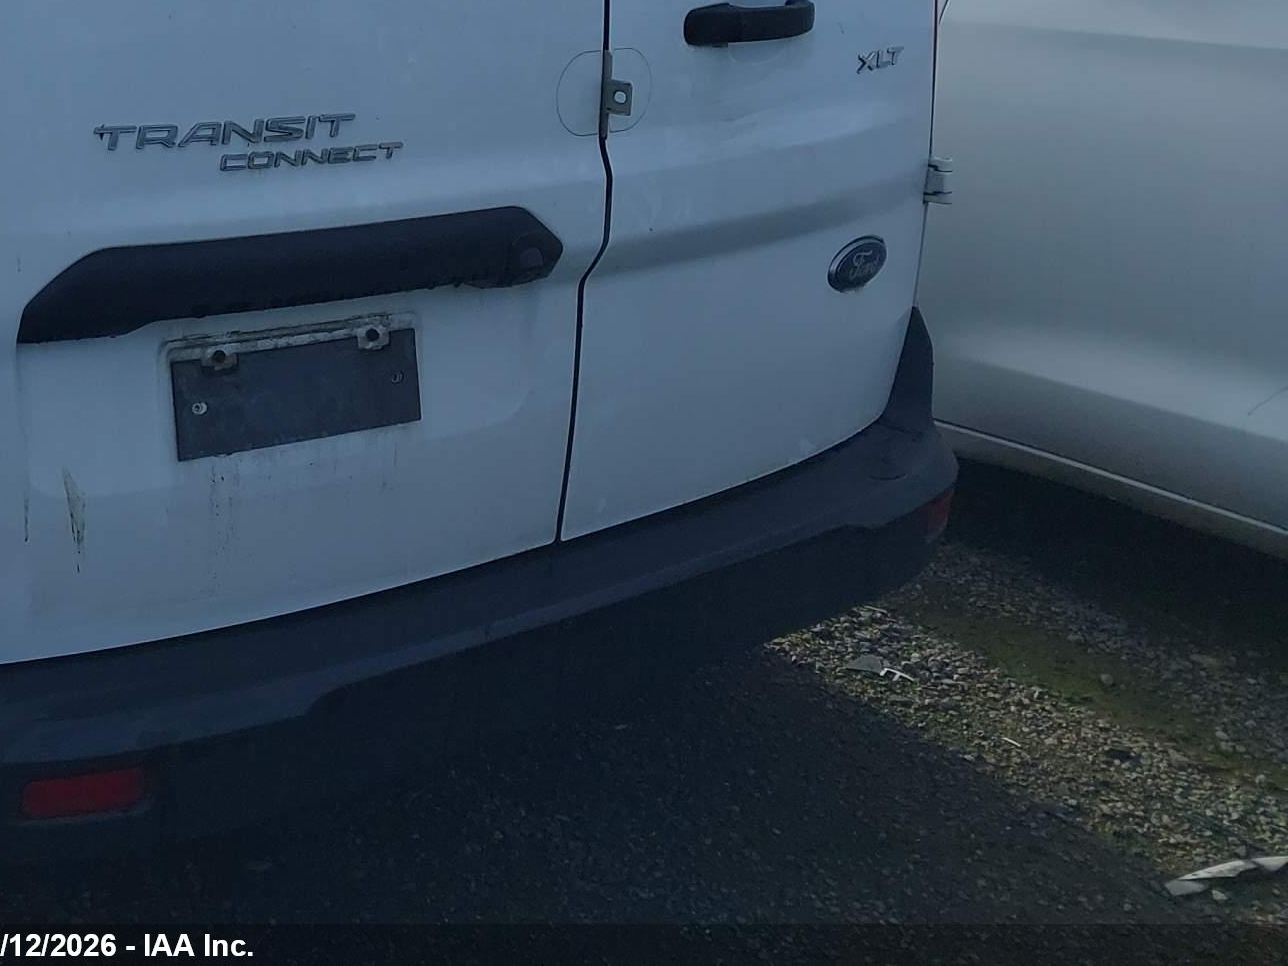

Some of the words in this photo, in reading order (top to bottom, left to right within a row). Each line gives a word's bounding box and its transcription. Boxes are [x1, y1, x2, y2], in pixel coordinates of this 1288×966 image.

[856, 46, 905, 75] XLT
[94, 113, 356, 151] TRANSIT
[220, 141, 404, 172] CONNECT
